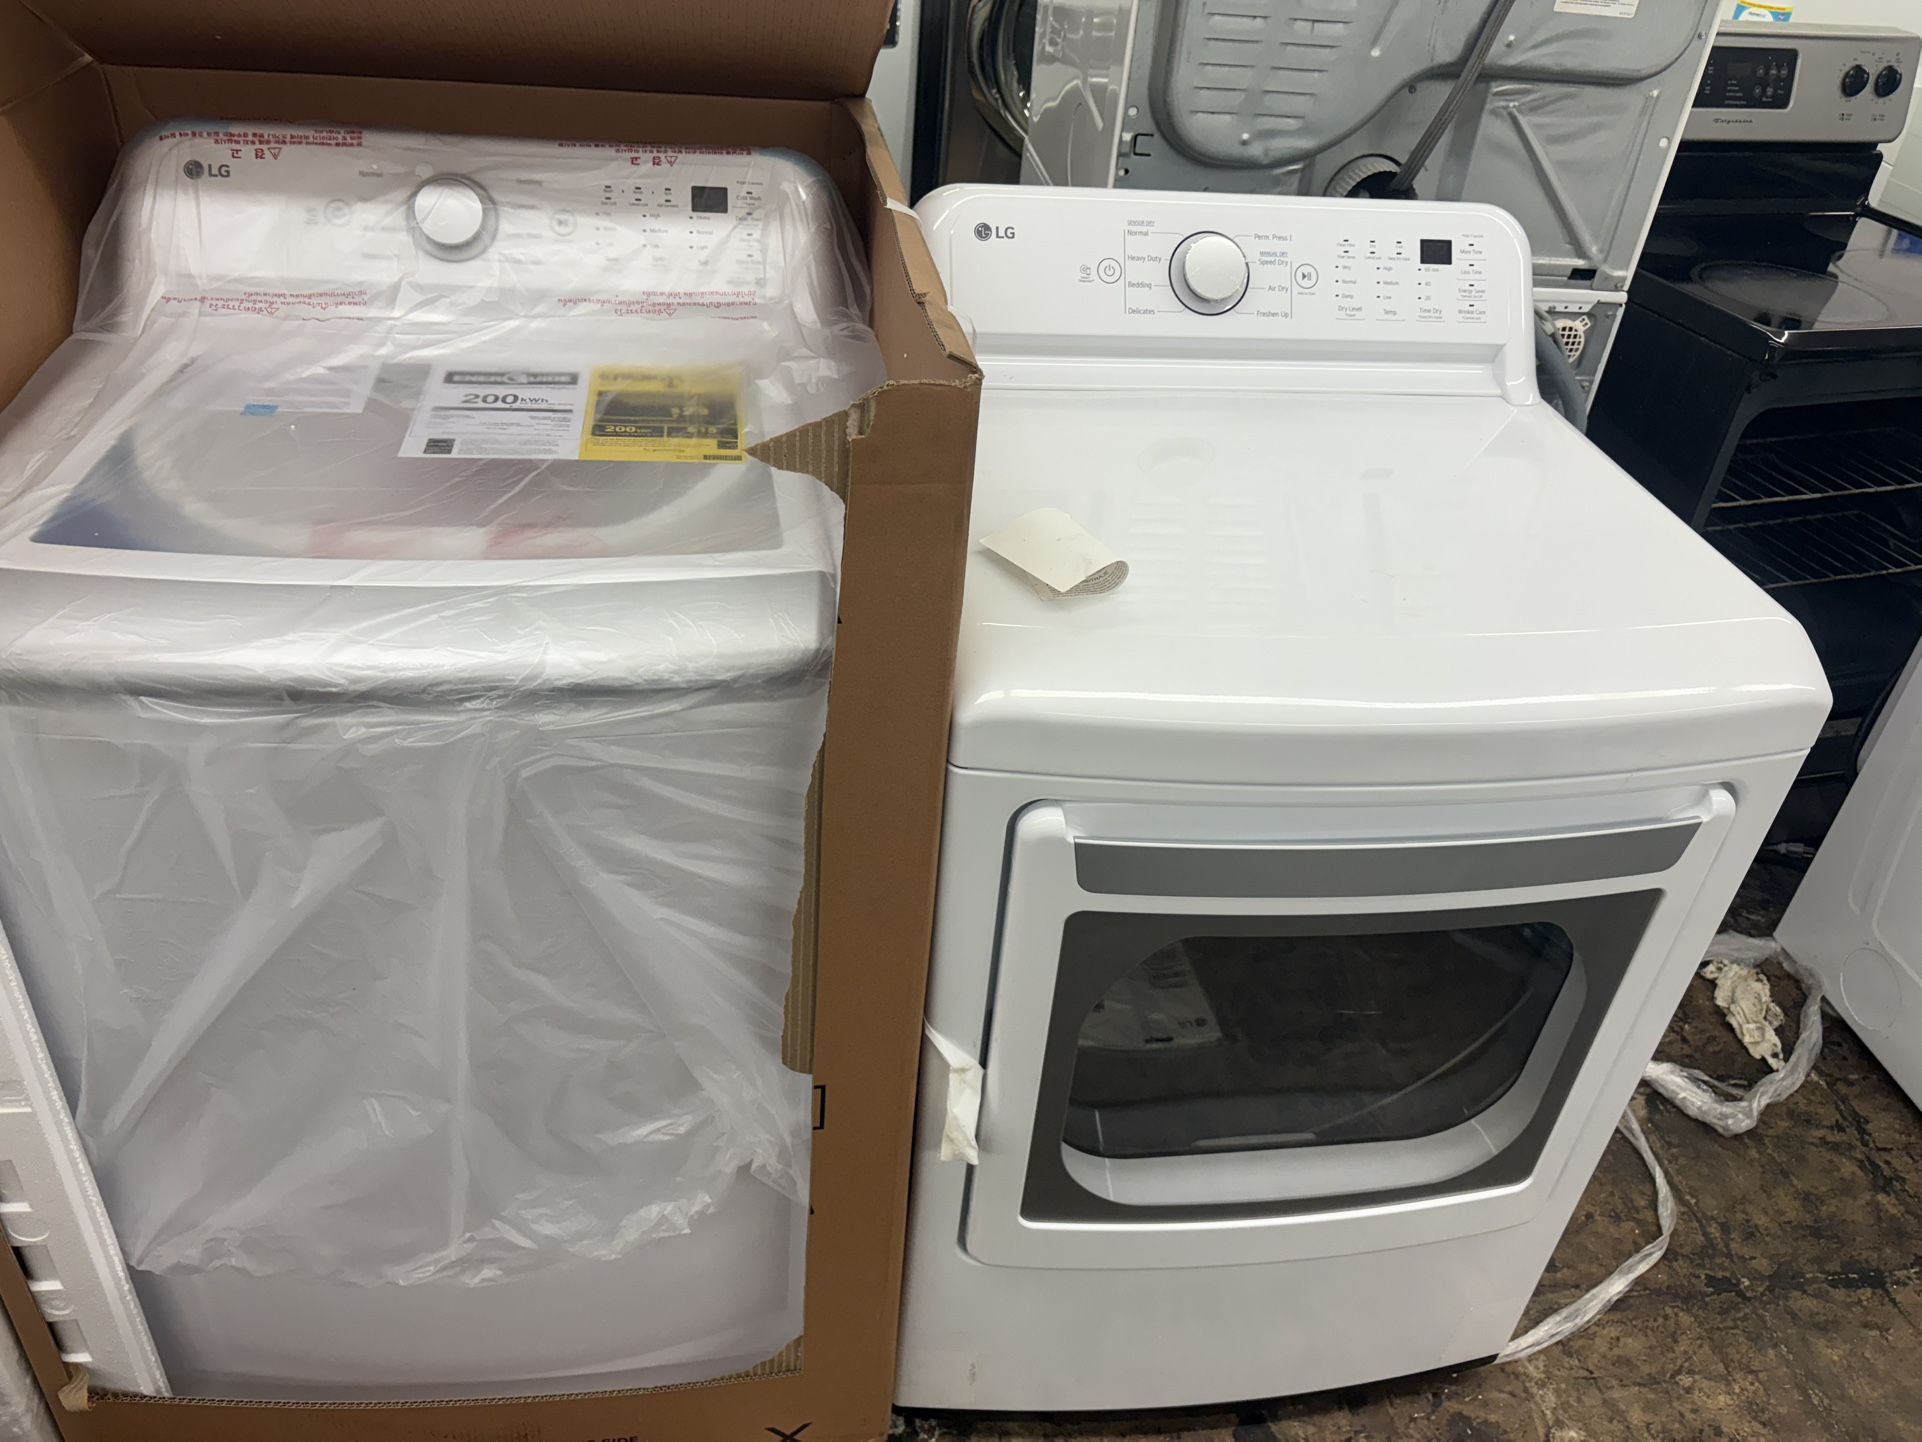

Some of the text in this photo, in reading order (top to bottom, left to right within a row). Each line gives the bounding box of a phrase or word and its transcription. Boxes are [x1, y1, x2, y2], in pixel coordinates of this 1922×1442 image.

[230, 148, 266, 160] 경 고
[630, 155, 662, 166] 경 고
[207, 163, 231, 178] LG
[995, 225, 1016, 240] LG
[1127, 229, 1149, 237] Normal
[1272, 233, 1288, 241] Press
[1127, 254, 1162, 264] Heavy Duty
[1258, 258, 1288, 267] Speed Dry
[1127, 280, 1152, 290] Bedding
[1267, 285, 1276, 293] Air
[1278, 285, 1288, 294] Dry
[1127, 307, 1155, 315] Delicates
[1337, 304, 1348, 313] Dry
[1256, 310, 1289, 319] Freshen Up
[460, 393, 519, 405] 200
[604, 425, 637, 433] 200
